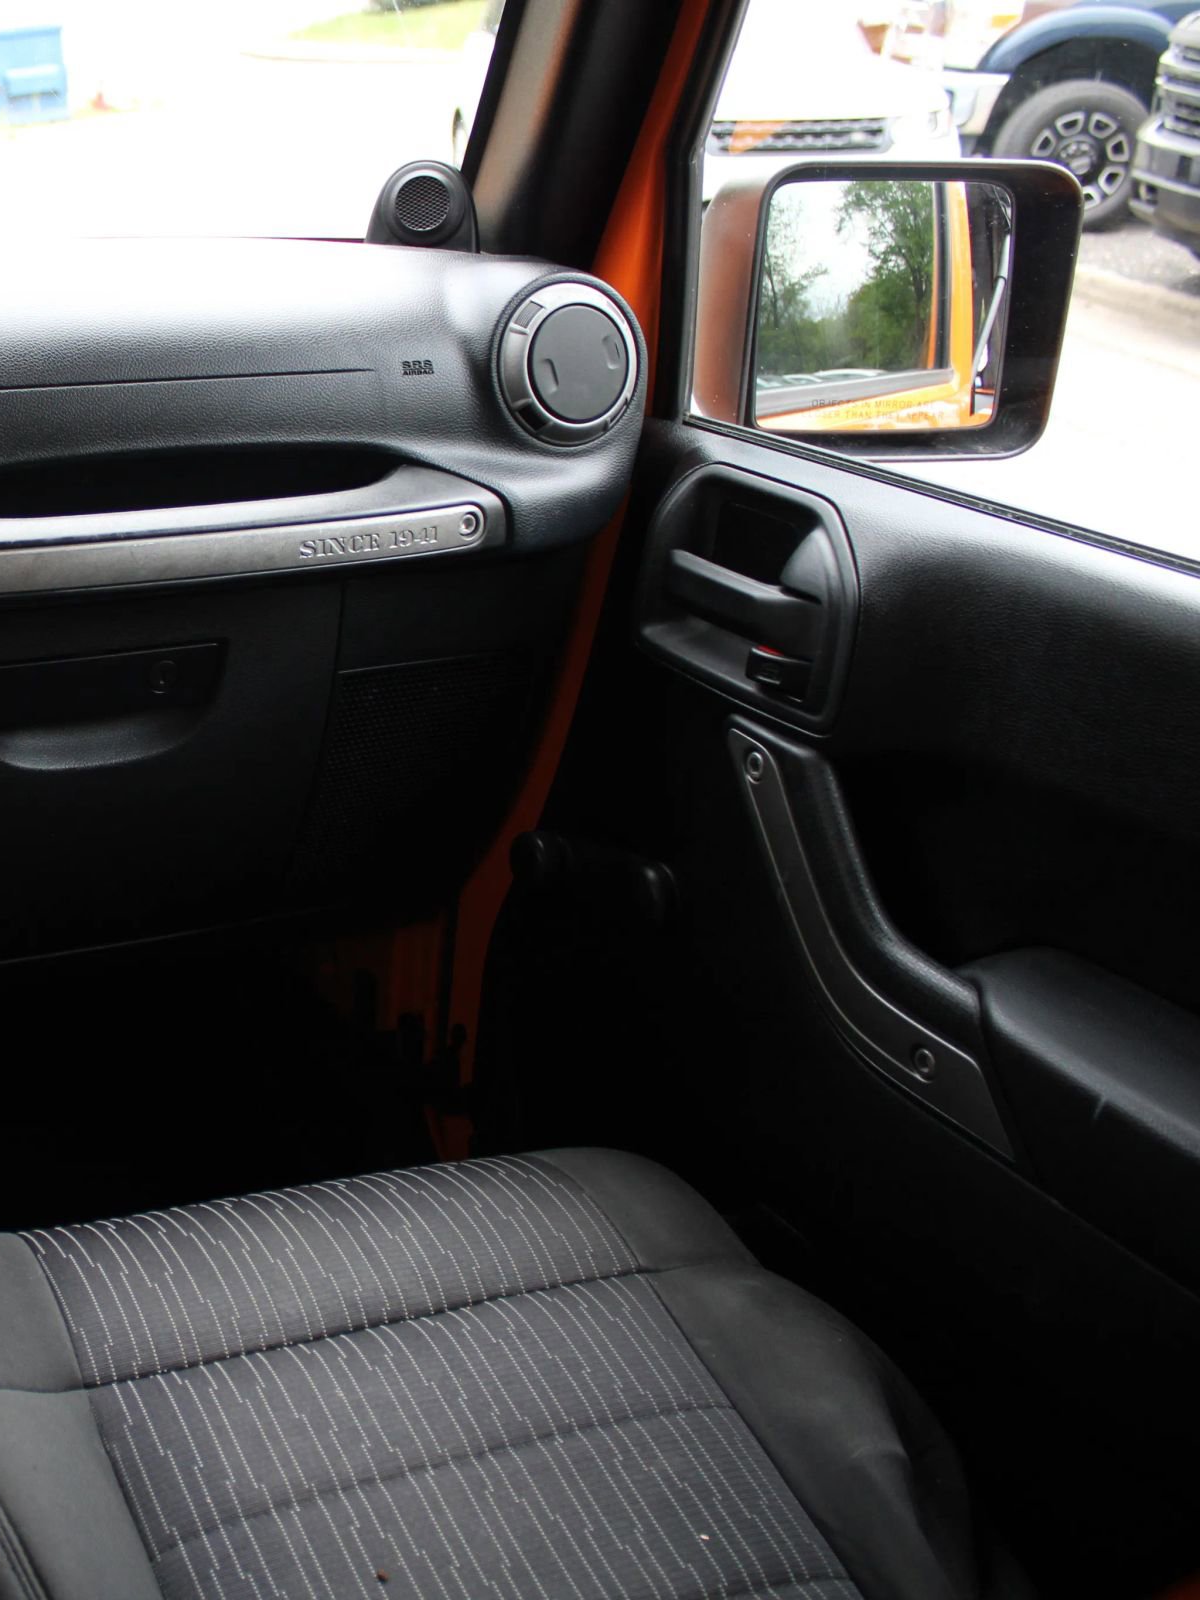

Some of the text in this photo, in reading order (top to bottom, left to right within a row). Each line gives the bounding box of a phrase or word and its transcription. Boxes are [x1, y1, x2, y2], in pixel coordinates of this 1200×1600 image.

[402, 360, 433, 369] SRS
[300, 525, 440, 559] SINCE 1941
